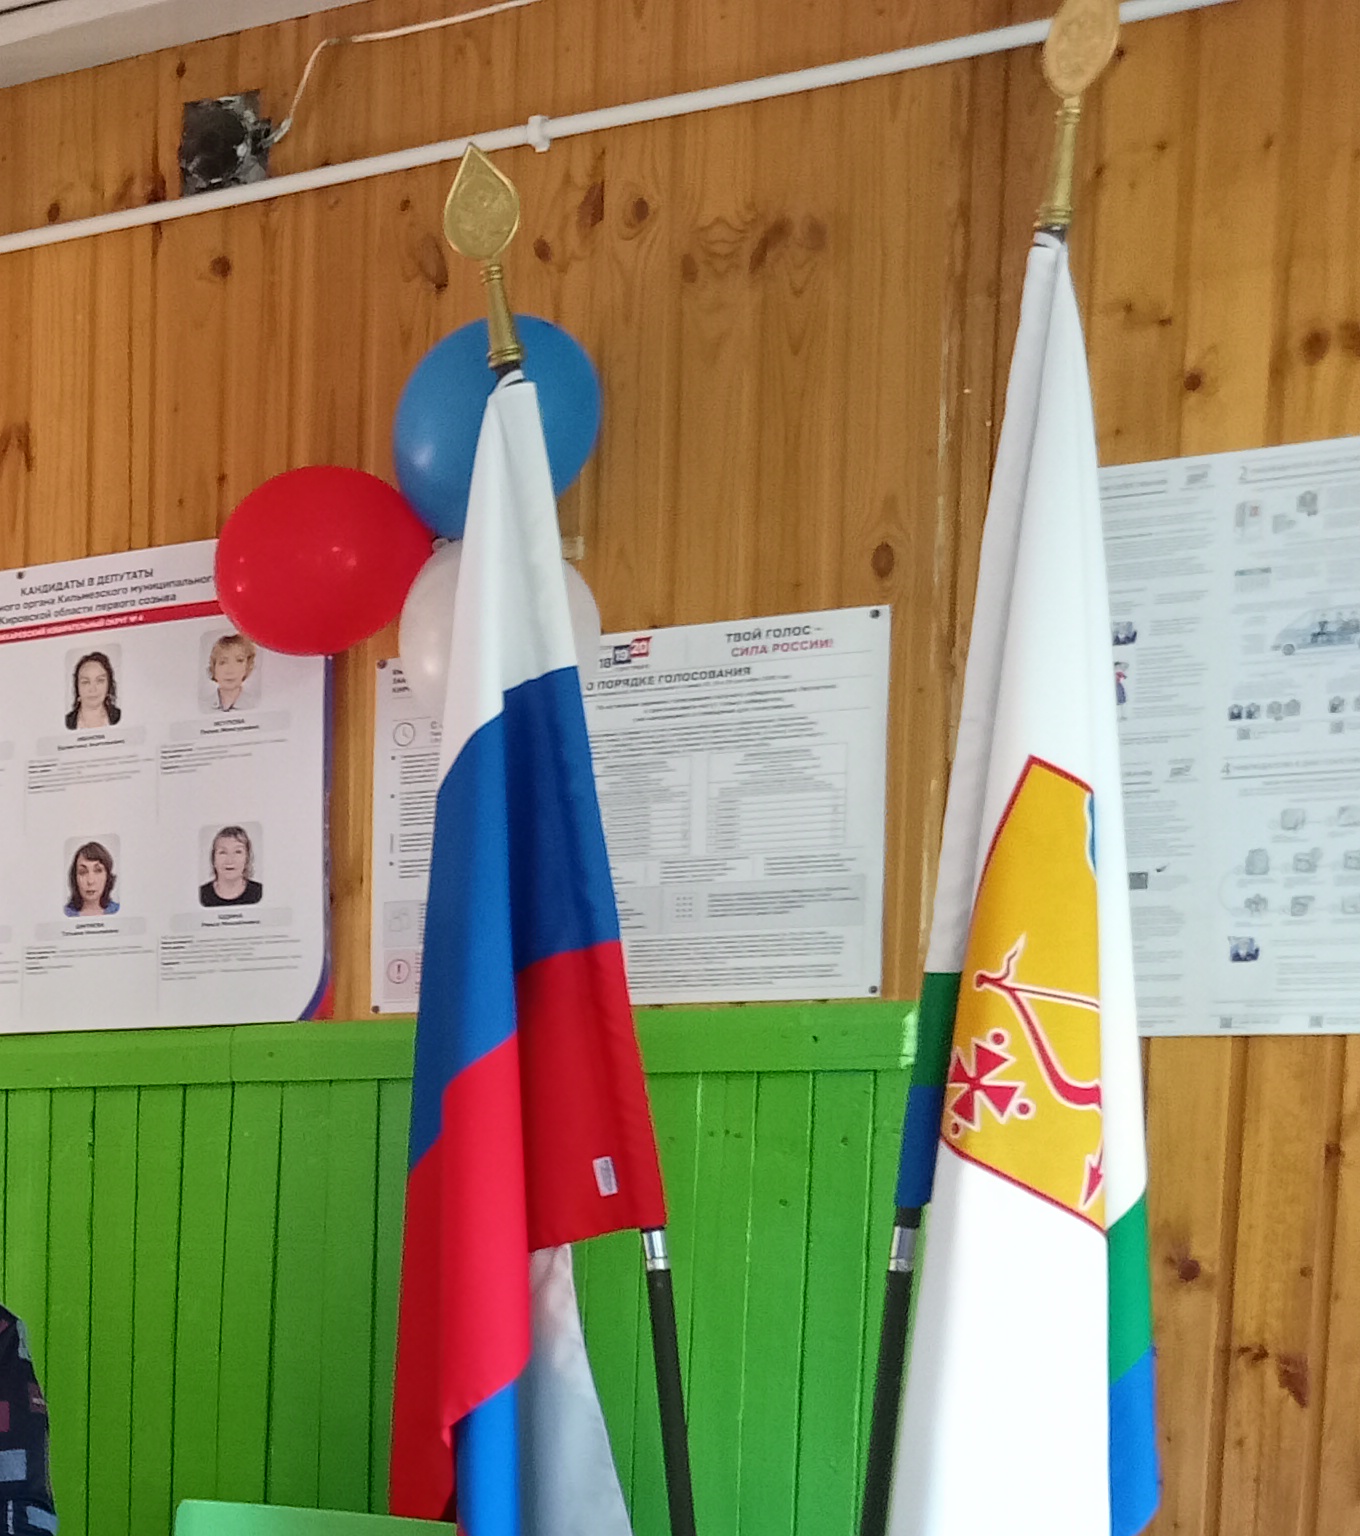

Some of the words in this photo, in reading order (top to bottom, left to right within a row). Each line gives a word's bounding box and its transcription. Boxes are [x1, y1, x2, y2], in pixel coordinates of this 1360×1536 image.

[20, 579, 85, 595] КАНДИДАТЫ
[86, 577, 94, 586] В
[96, 568, 153, 585] ДЕПУТАТЫ
[130, 573, 216, 593] муниципальног
[53, 606, 93, 617] области
[94, 599, 136, 610] первого
[137, 594, 177, 605] созыва
[725, 628, 762, 642] ТВОЙ
[765, 625, 811, 638] ГОЛОС
[730, 644, 768, 657] СИЛА
[771, 639, 833, 652] РОССИИ!
[585, 681, 594, 691] О
[596, 675, 655, 689] ПОРЯДКЕ
[657, 666, 751, 683] ГОЛОСОВАНИЯ
